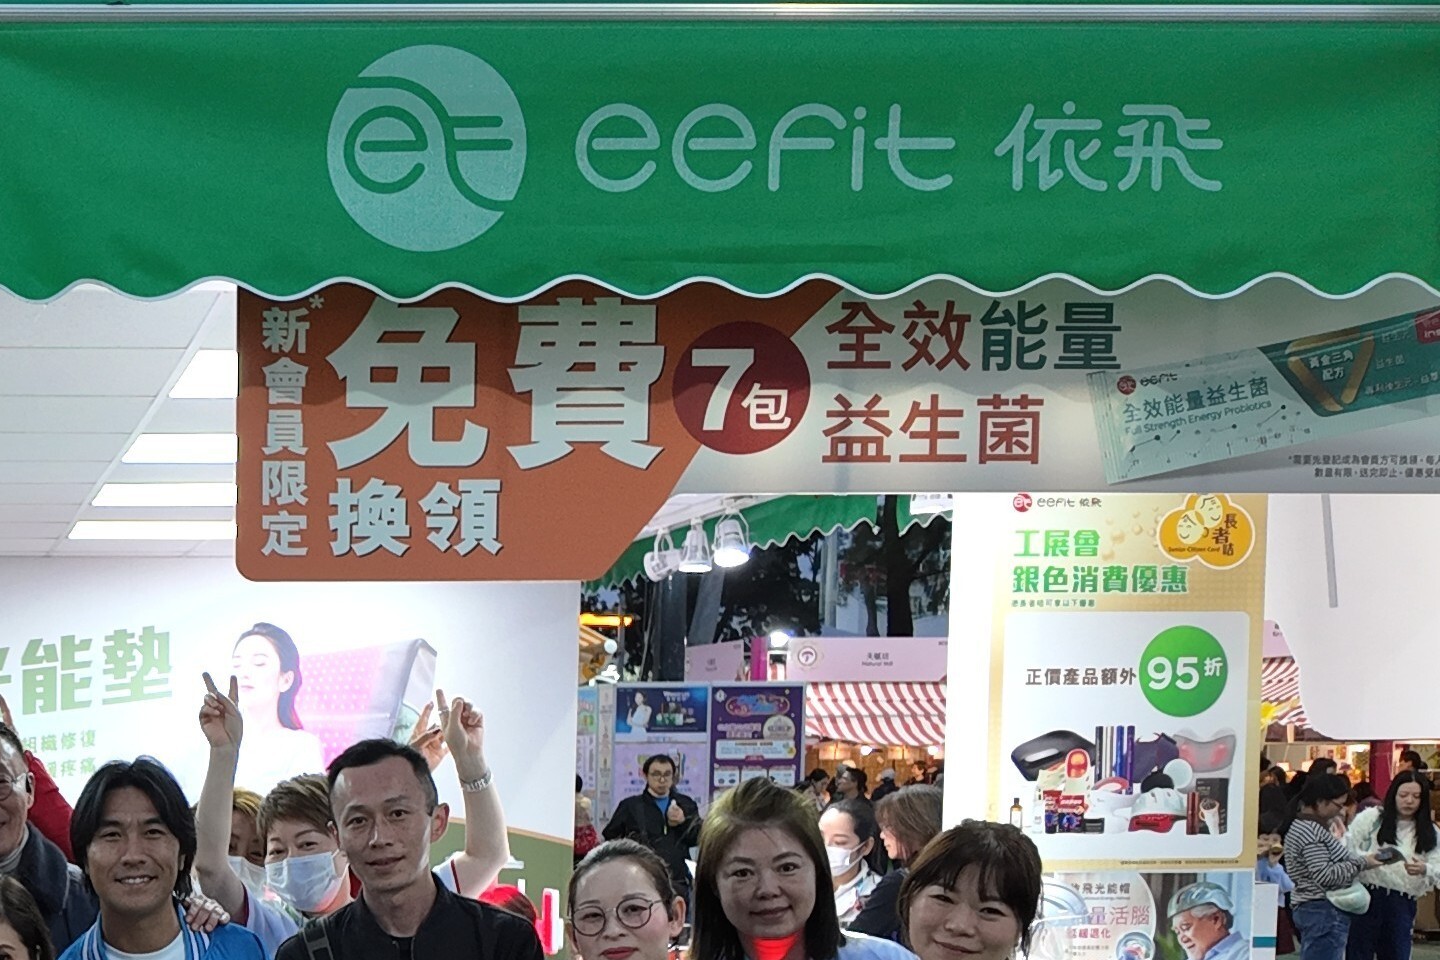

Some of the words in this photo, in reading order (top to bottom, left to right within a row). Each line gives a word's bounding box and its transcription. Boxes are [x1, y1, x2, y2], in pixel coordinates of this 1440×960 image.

[575, 102, 956, 192] eefit
[994, 102, 1224, 192] 依飛
[825, 301, 1122, 372] 全效能量
[326, 297, 665, 470] 免費
[691, 348, 791, 431] 7包
[1122, 376, 1270, 424] 全效能量益生菌
[1144, 414, 1187, 433] Strength
[1188, 408, 1222, 426] Energy
[1224, 398, 1272, 419] Probiotics
[261, 307, 310, 557] 新會員限定
[822, 394, 1044, 465] 益生菌
[328, 477, 503, 558] 換領
[1013, 529, 1101, 558] 工展會
[1012, 565, 1190, 595] 銀色消費優惠
[1025, 667, 1137, 686] 正價產品額外
[1147, 656, 1224, 691] 95折
